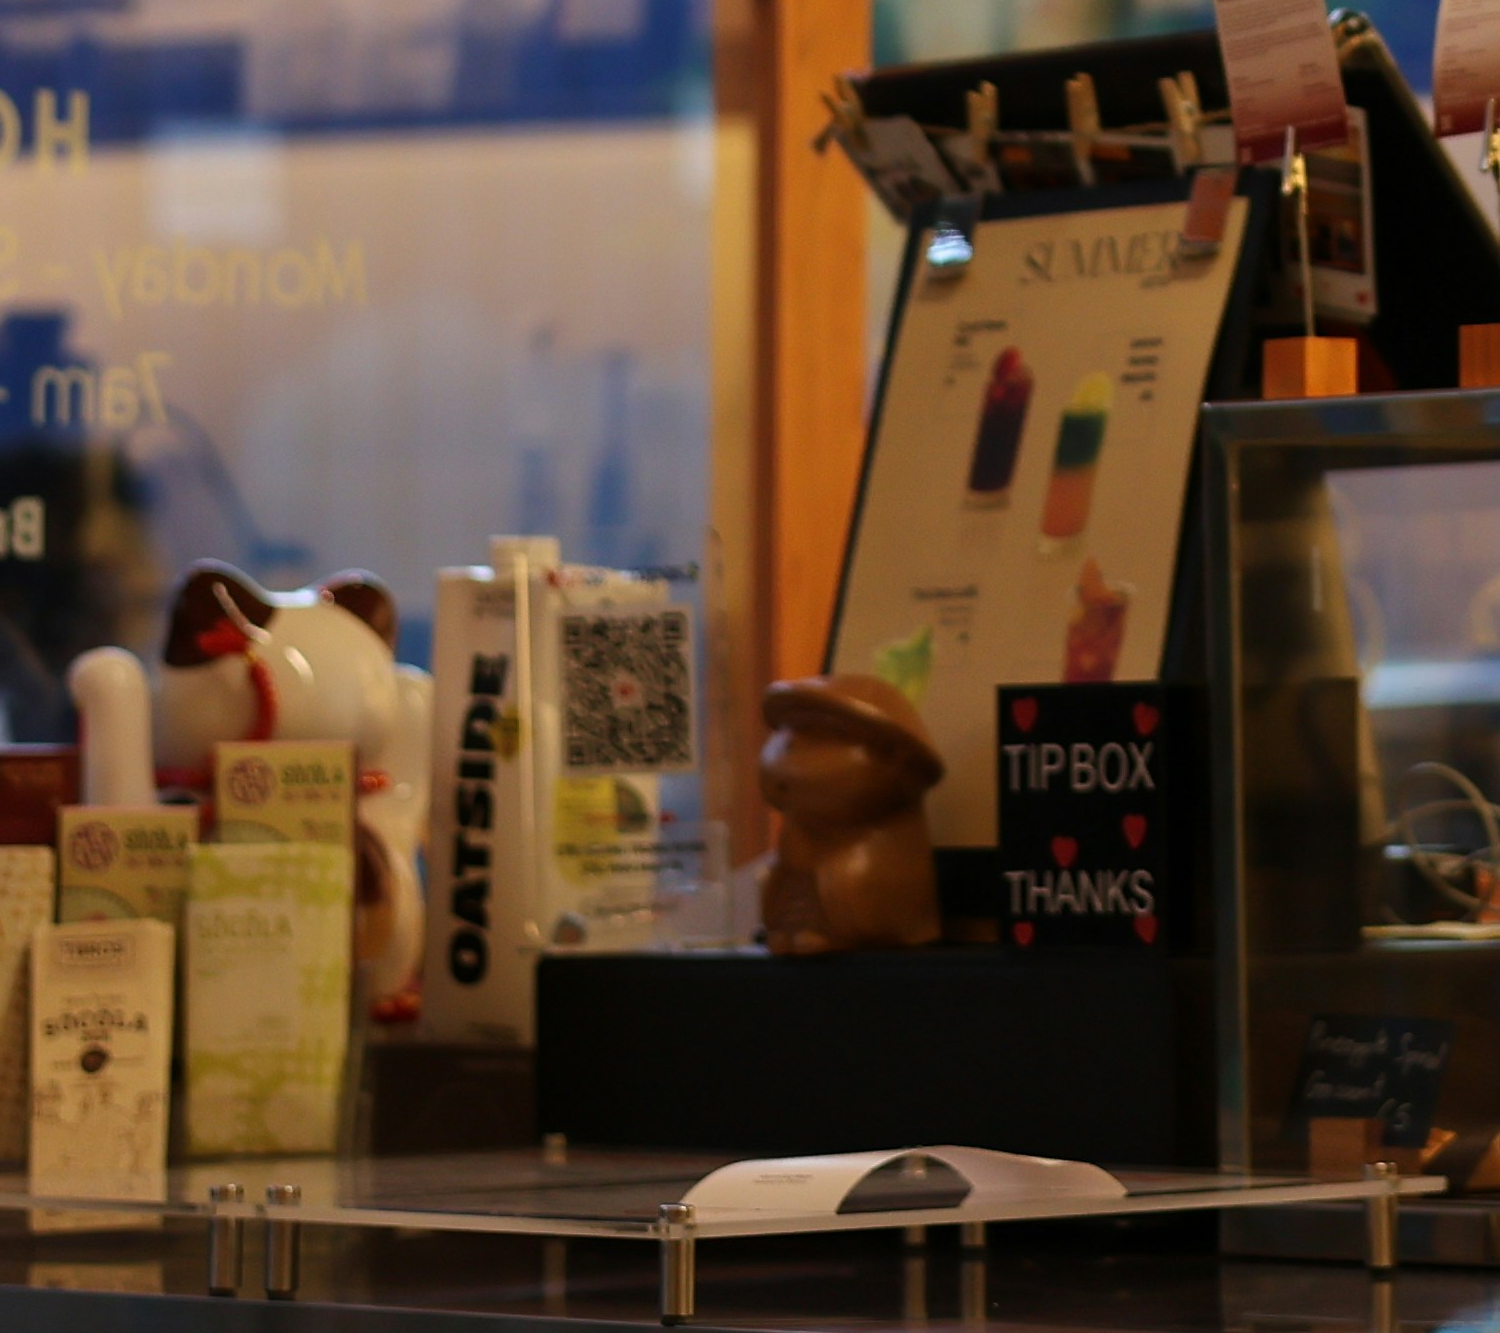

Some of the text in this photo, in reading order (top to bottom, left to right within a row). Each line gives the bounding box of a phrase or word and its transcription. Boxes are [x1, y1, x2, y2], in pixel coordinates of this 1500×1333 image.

[1002, 742, 1156, 793] TIP BOX
[449, 654, 509, 984] OATSIDE
[1003, 869, 1155, 916] THANKS
